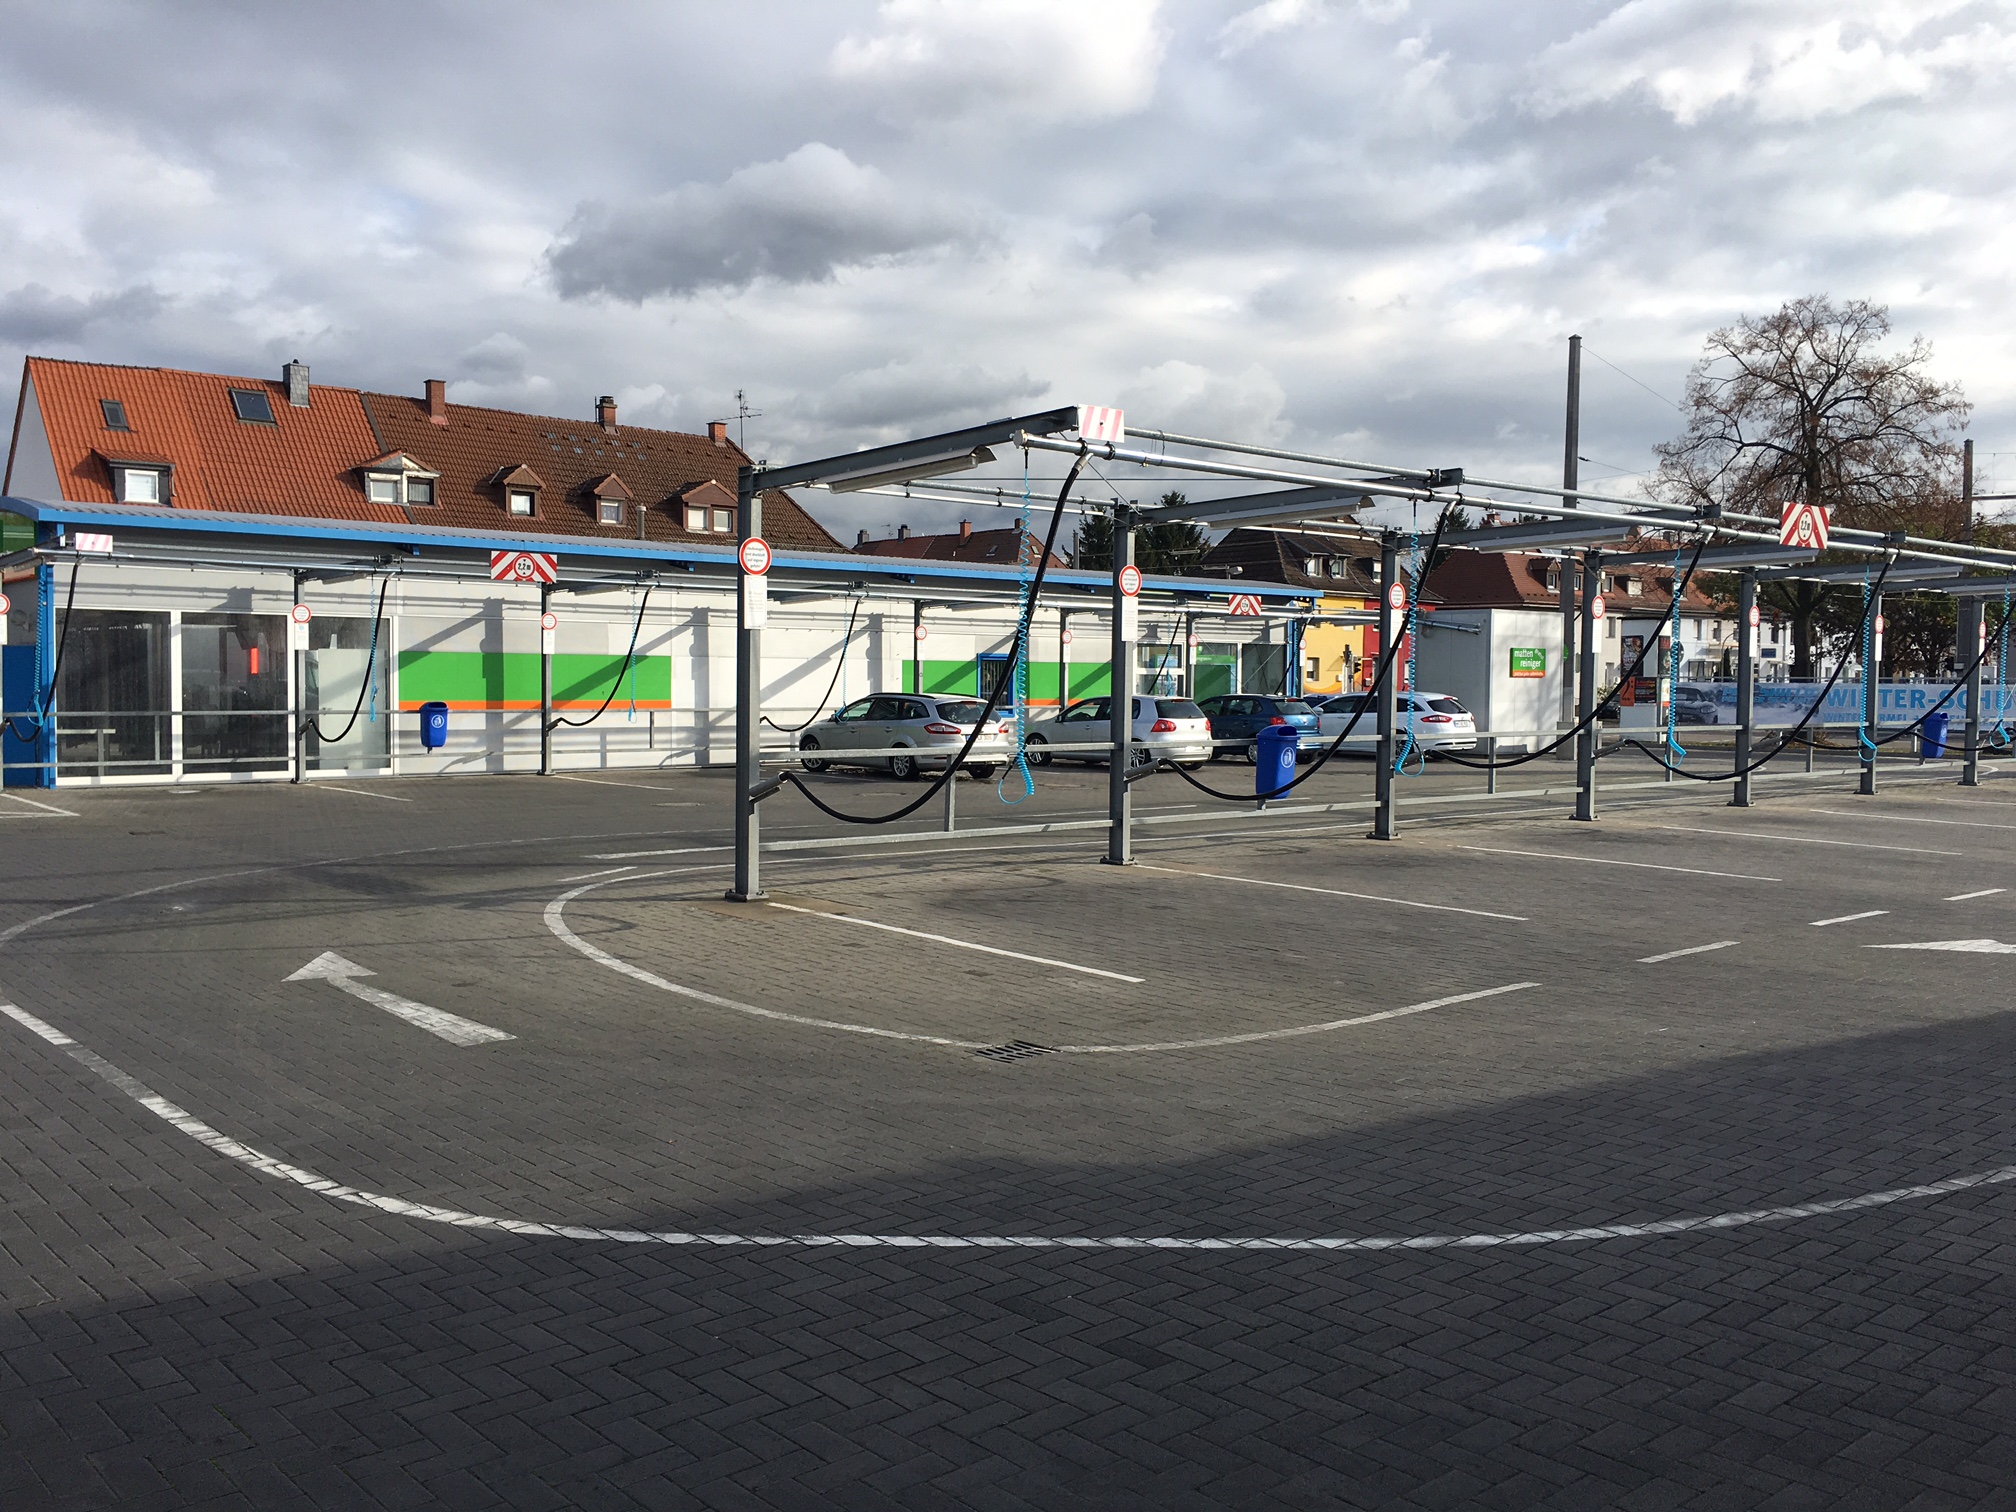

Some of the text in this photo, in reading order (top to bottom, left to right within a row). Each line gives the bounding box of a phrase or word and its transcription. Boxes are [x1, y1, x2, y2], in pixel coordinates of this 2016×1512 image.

[518, 563, 526, 571] 2,2
[1514, 649, 1533, 657] matten
[1520, 659, 1541, 670] reiniger
